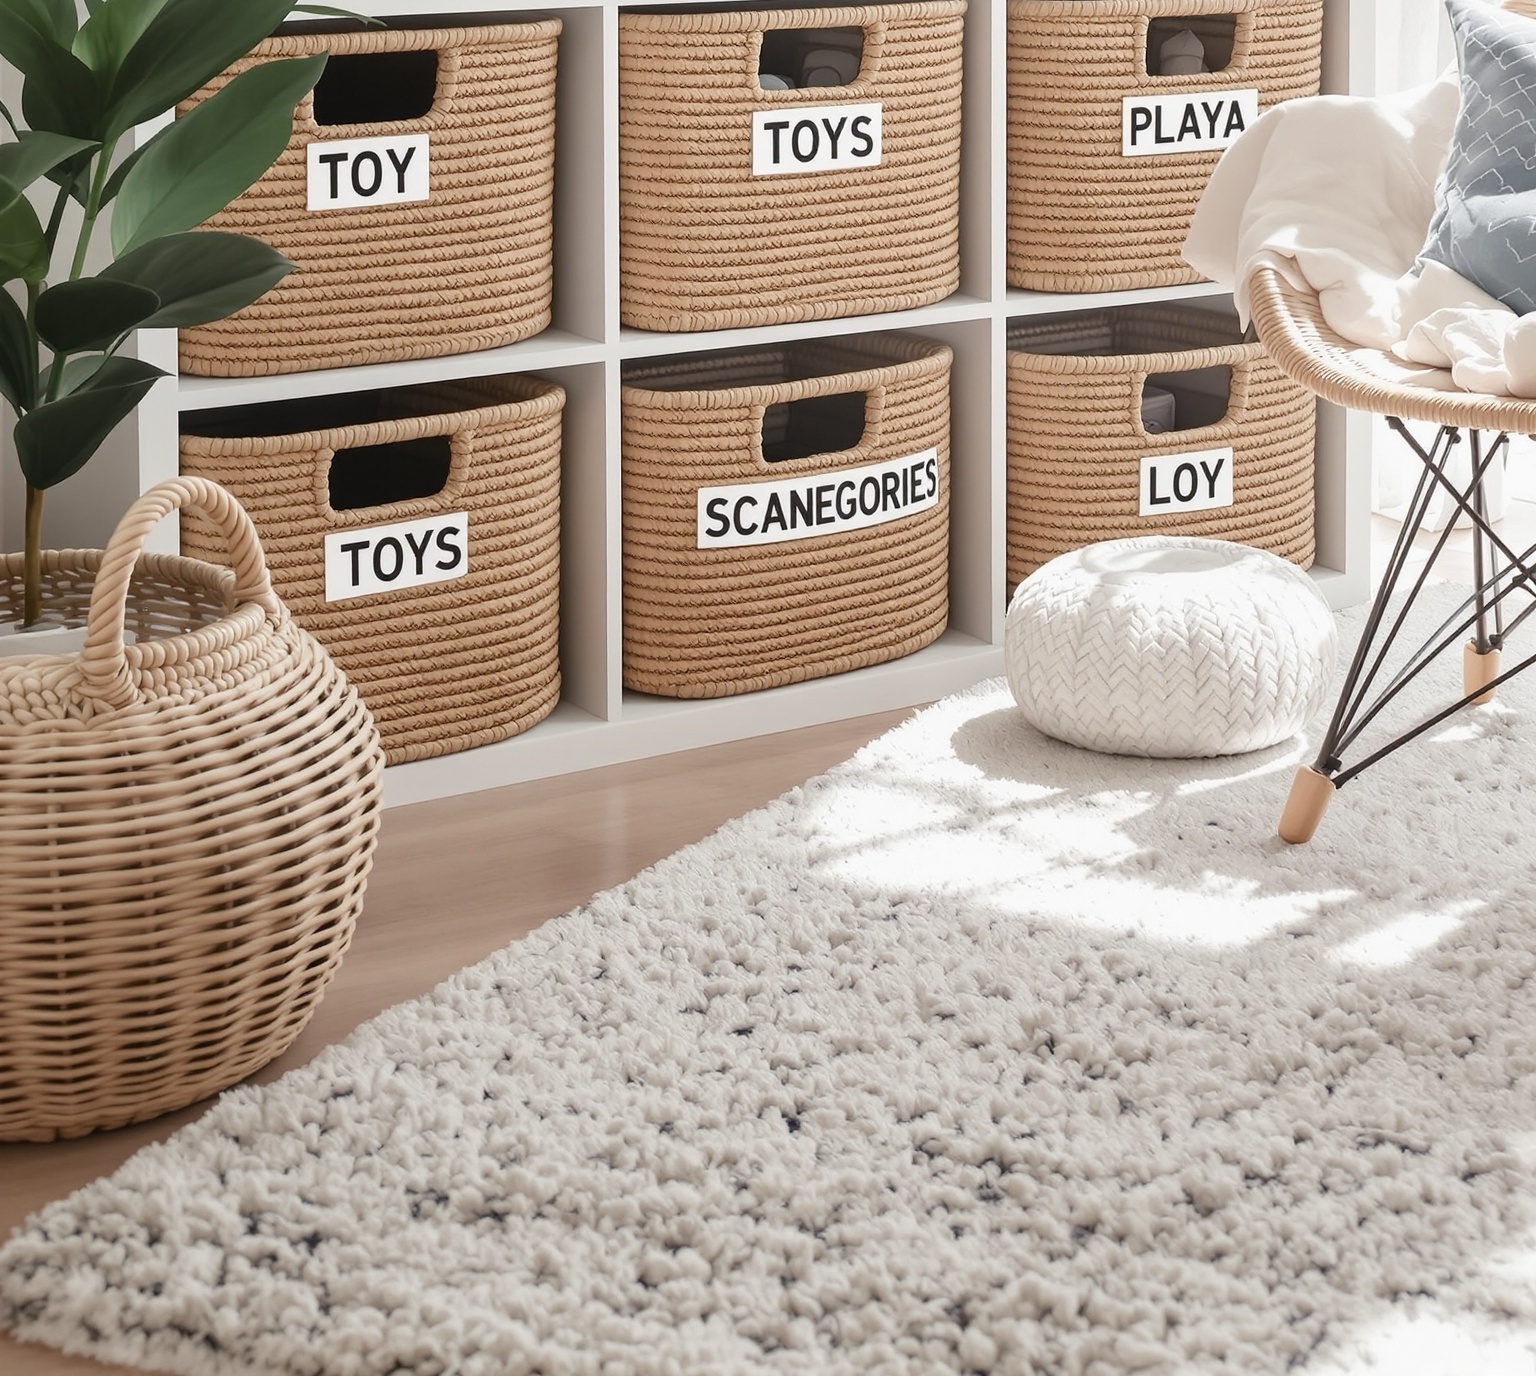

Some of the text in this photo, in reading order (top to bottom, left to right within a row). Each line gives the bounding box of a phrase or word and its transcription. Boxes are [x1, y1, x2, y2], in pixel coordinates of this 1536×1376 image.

[763, 115, 874, 164] TOYS
[1130, 100, 1246, 146] PLAYA
[318, 147, 417, 199] TOY
[705, 458, 937, 538] SCANEGORIES
[1149, 458, 1225, 506] LOY
[340, 526, 462, 587] TOYS
